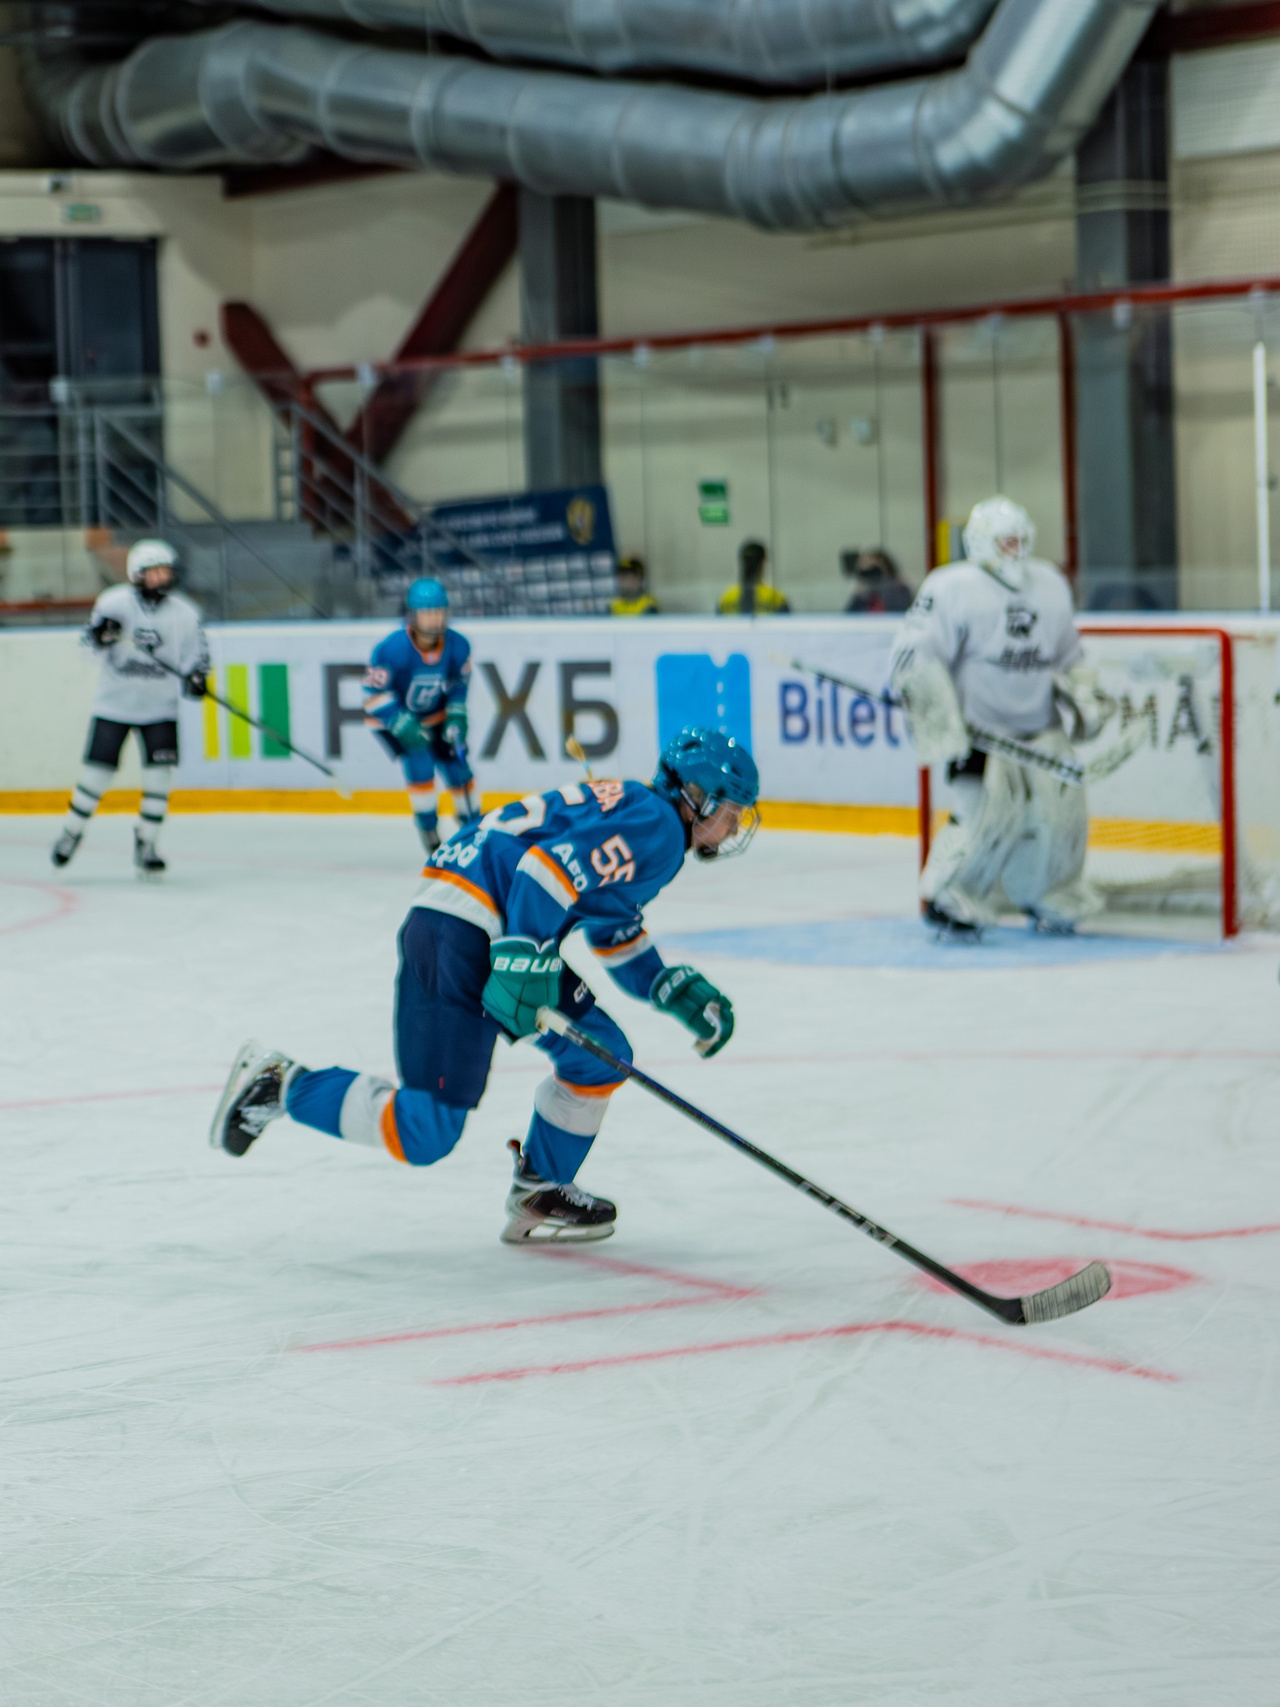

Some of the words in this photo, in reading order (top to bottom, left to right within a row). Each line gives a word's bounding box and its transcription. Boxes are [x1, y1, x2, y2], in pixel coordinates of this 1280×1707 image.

[780, 674, 914, 747] Bilet
[493, 956, 562, 974] BAUE
[801, 1181, 898, 1248] CCM
